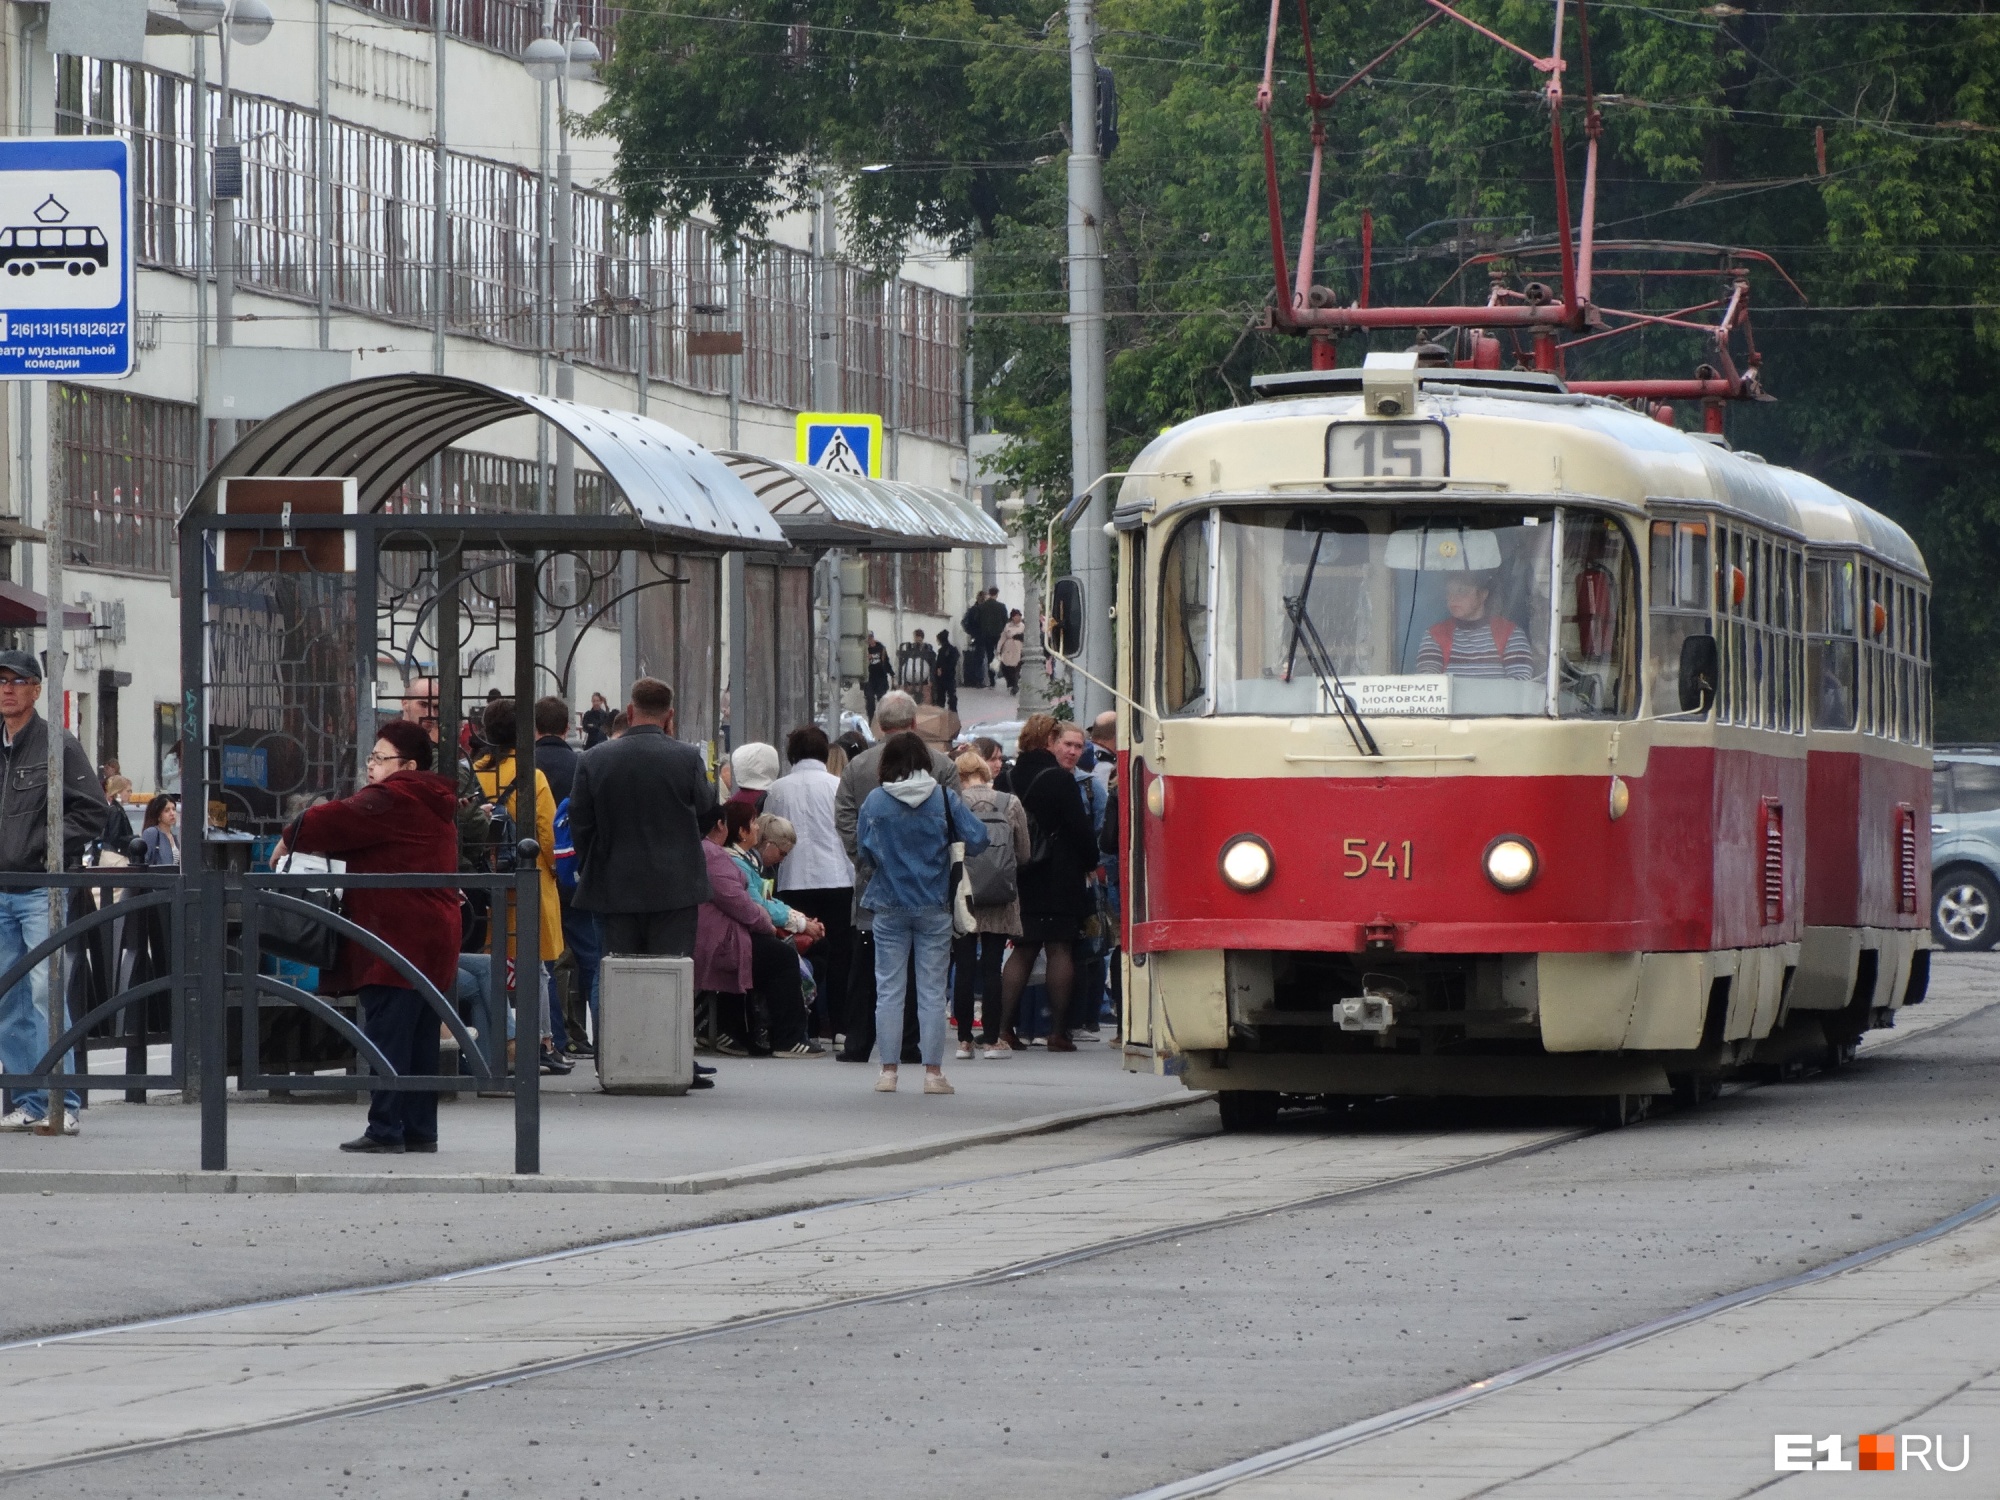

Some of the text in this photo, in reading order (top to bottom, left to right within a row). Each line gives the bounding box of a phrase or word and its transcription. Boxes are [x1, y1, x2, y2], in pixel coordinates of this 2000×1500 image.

[28, 343, 116, 358] музыкальной
[24, 359, 80, 369] комедии
[1354, 428, 1422, 486] 15
[1362, 683, 1439, 693] ВТОРЧЕРМЕТ
[1343, 839, 1412, 879] 541
